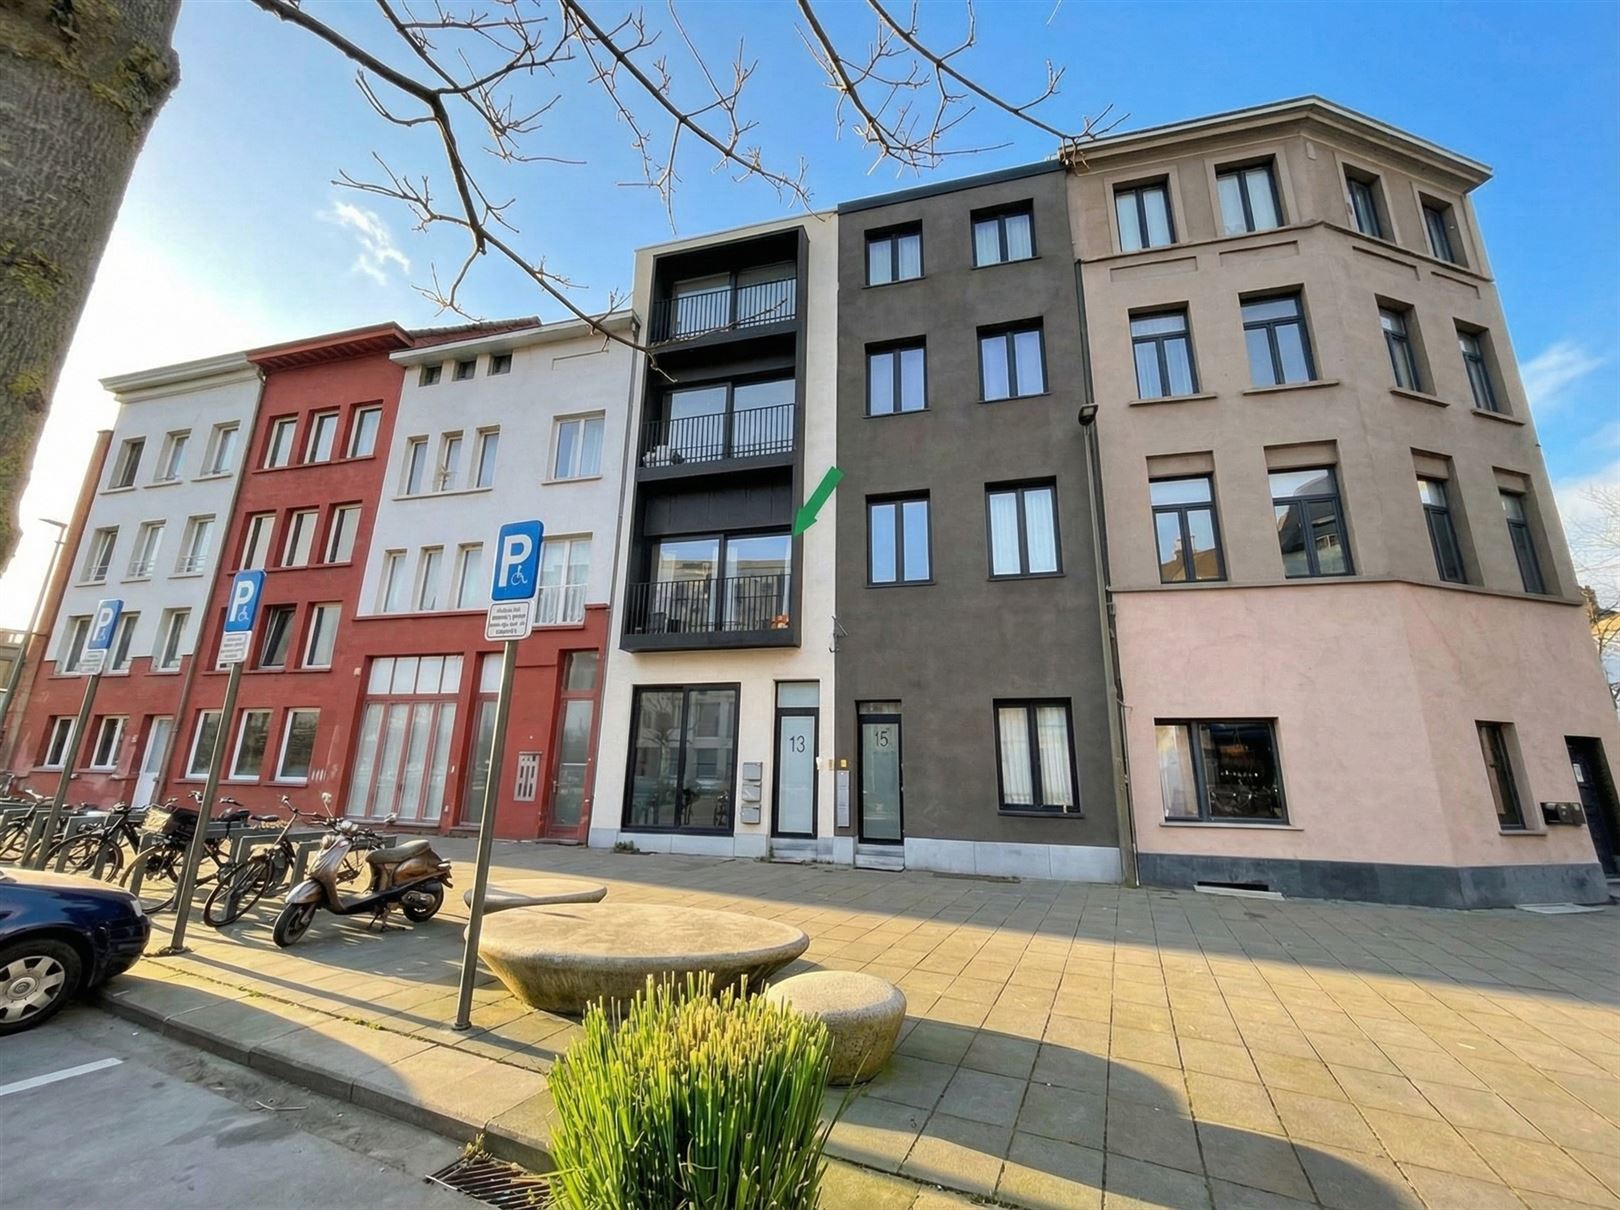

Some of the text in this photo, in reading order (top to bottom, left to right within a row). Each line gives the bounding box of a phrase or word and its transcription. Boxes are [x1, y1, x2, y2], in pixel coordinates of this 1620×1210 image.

[498, 533, 532, 588] P
[229, 580, 254, 622] P
[92, 607, 113, 641] P
[789, 735, 806, 753] 13
[875, 730, 889, 747] 15
